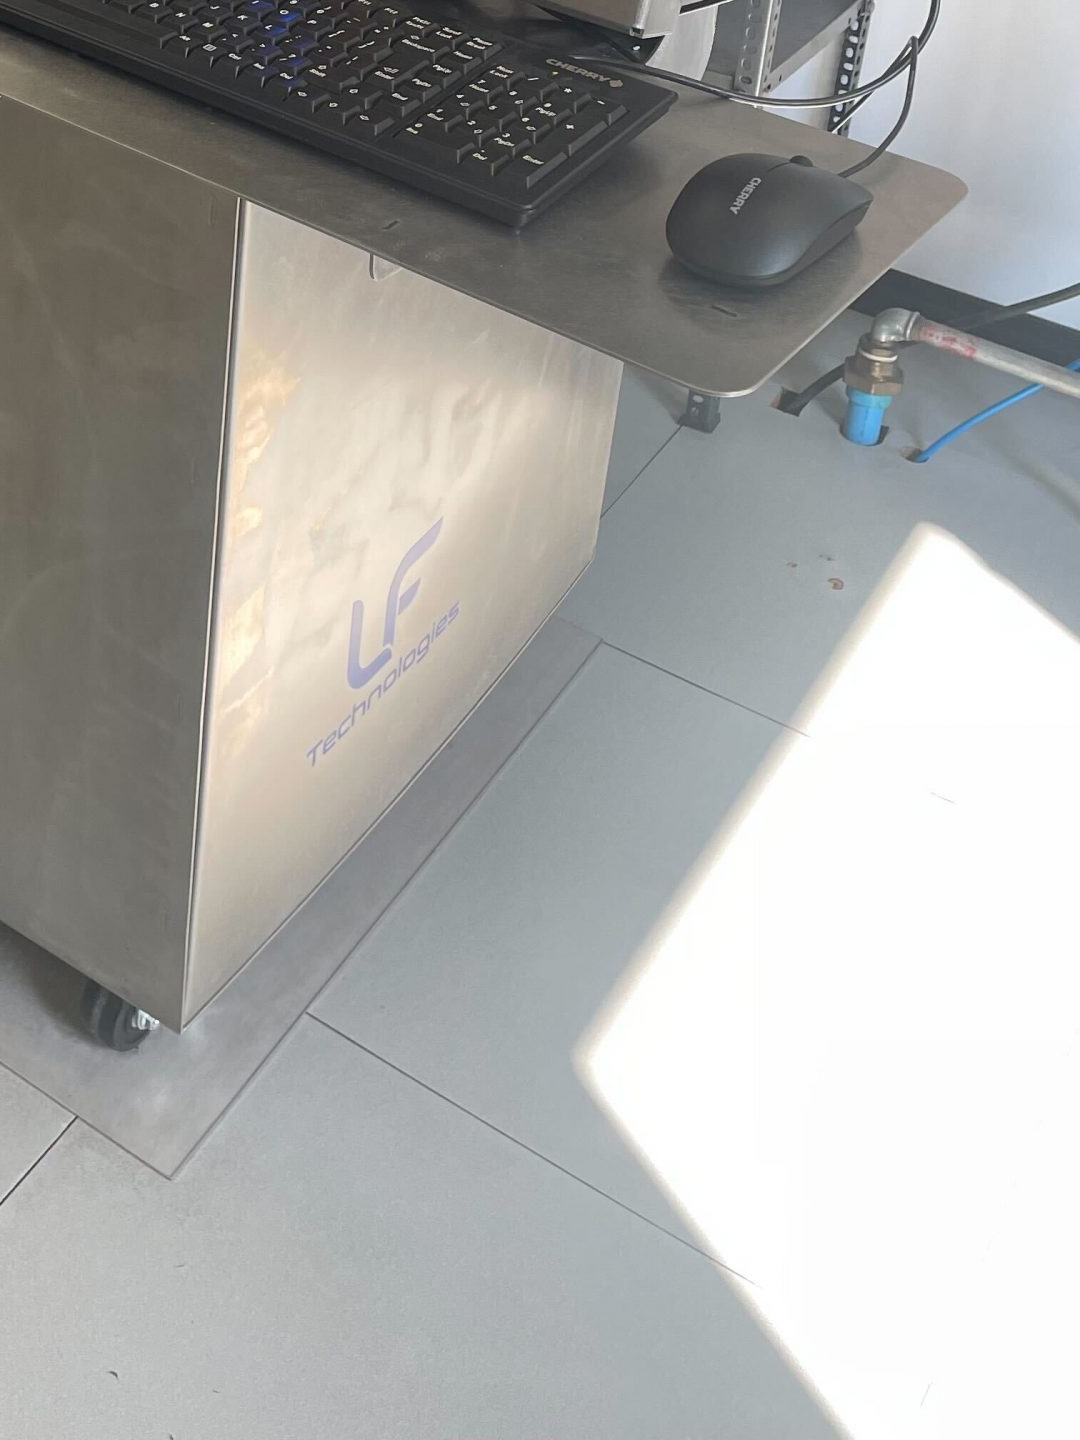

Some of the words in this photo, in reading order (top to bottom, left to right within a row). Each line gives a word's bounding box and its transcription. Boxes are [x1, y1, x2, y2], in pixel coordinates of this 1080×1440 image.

[545, 58, 611, 82] CHERRY
[728, 176, 762, 216] CHERRY
[346, 515, 444, 690] LF
[306, 601, 460, 767] Technologies
